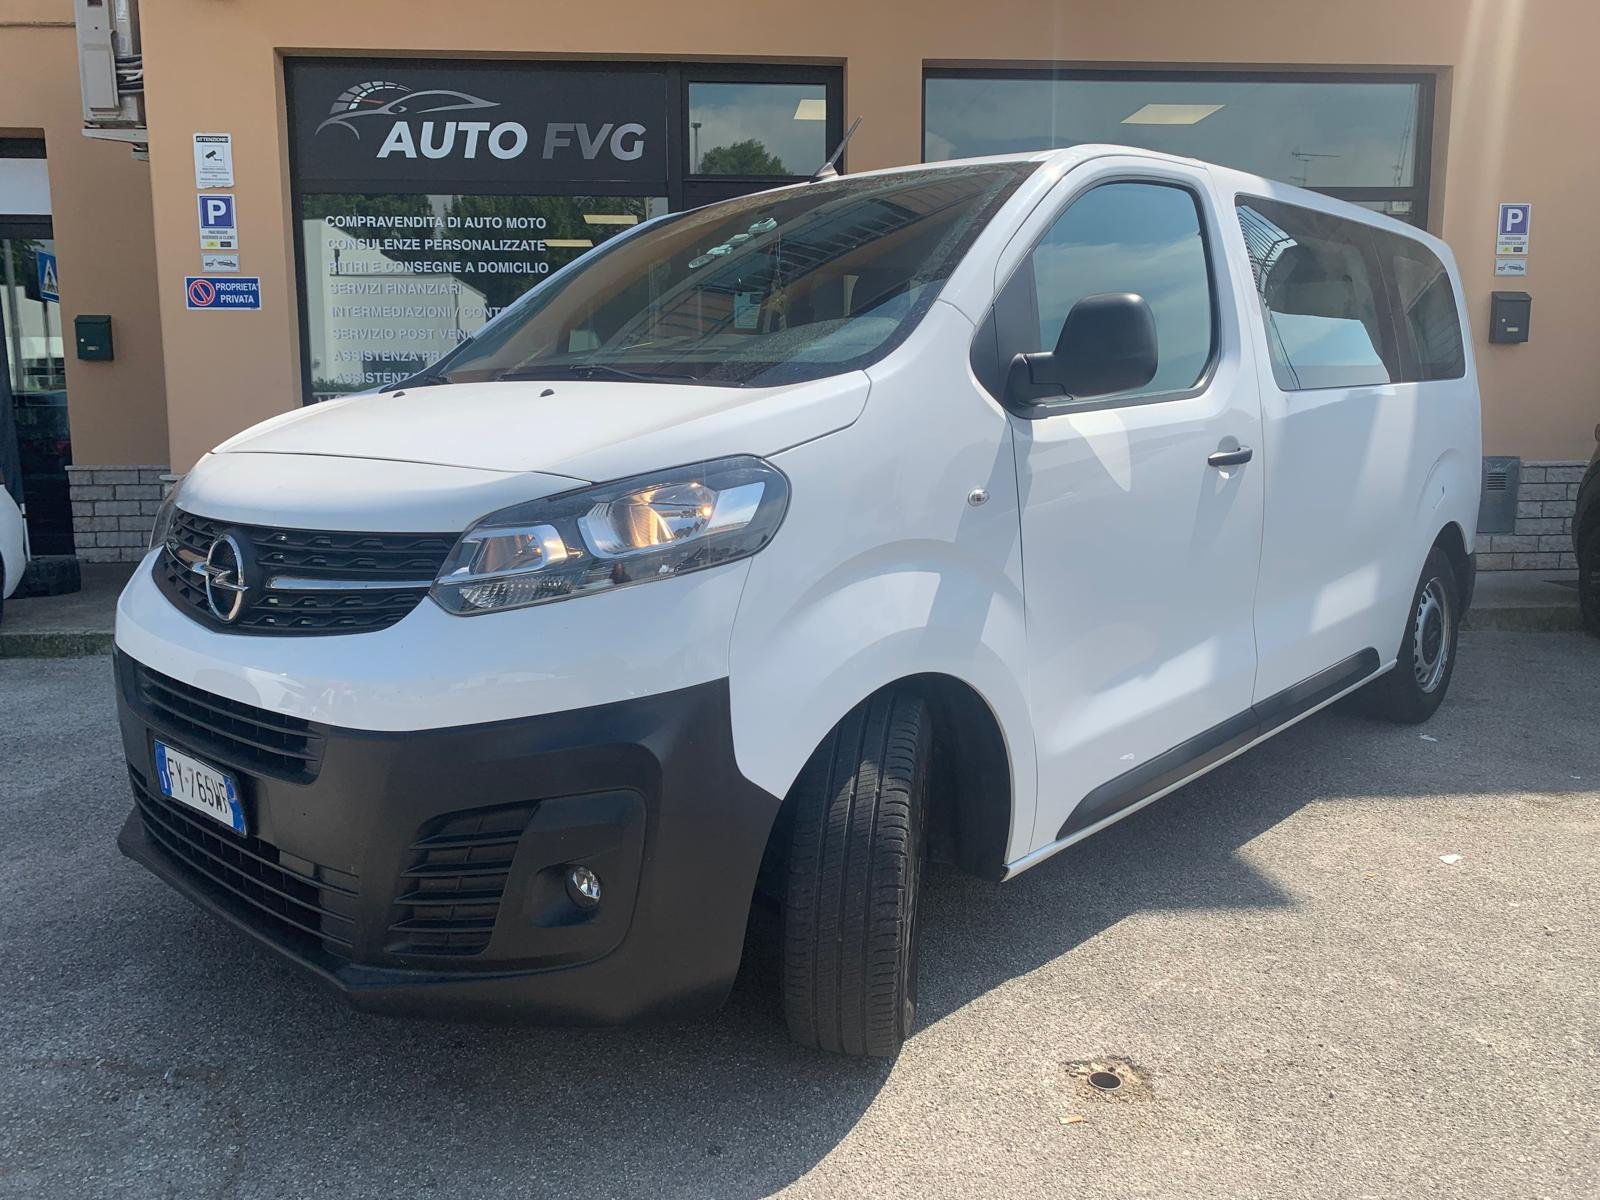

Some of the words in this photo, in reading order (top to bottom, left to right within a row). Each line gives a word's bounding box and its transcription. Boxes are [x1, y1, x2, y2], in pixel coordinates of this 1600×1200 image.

[376, 121, 528, 160] AUTO
[542, 122, 647, 161] FVG
[207, 200, 226, 225] P
[325, 215, 444, 228] COMPRAVENDITA
[447, 216, 461, 228] DI
[464, 217, 502, 229] AUTO
[506, 217, 547, 229] MOTO
[1506, 208, 1523, 232] P
[328, 239, 420, 250] CONSULENZE
[424, 239, 546, 252] PERSONALIZZATE
[329, 261, 368, 273] RITIRI
[385, 261, 462, 273] CONSEGNE
[465, 261, 475, 273] A
[478, 261, 549, 274] DOMICILIO
[330, 283, 383, 294] SERVIZI
[386, 283, 462, 295] FINANZIARI
[220, 295, 254, 303] PRIVATA
[331, 306, 451, 318] INTERMEDIAZIONI
[333, 328, 395, 340] SERVIZIO
[400, 328, 434, 340] POST
[334, 350, 419, 362] ASSISTENZA
[335, 371, 417, 384] ASSISTENZ
